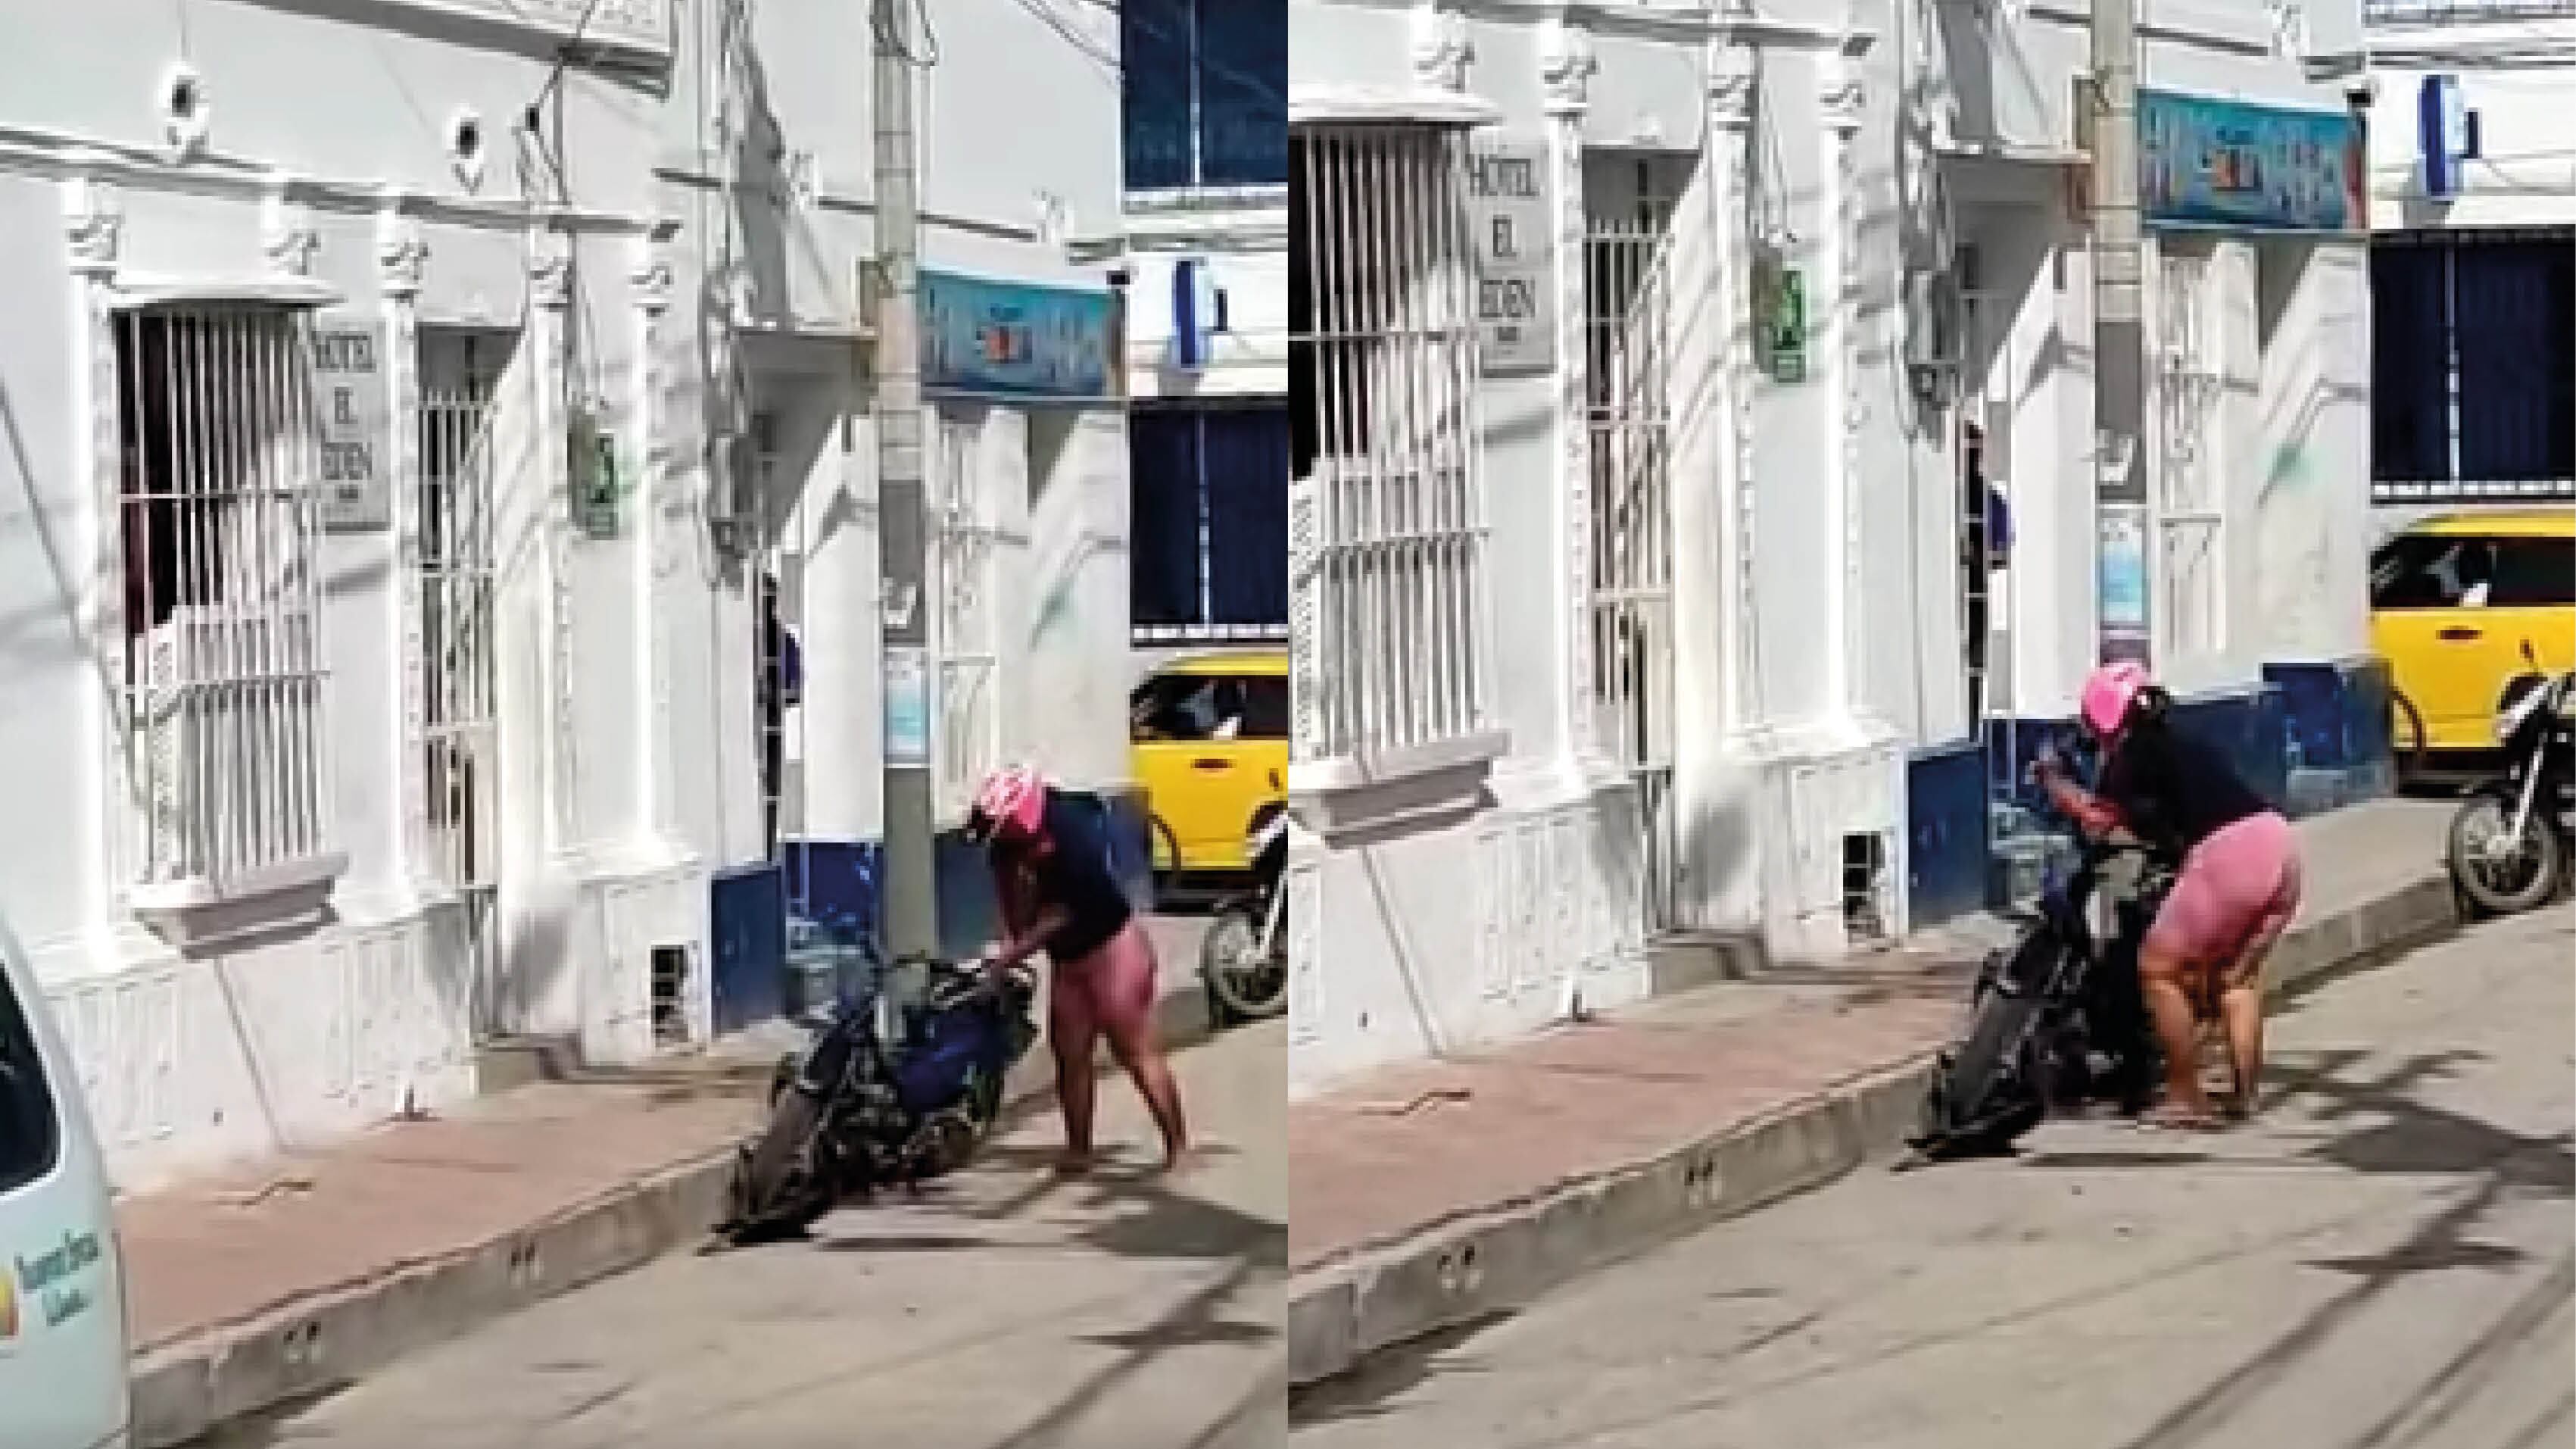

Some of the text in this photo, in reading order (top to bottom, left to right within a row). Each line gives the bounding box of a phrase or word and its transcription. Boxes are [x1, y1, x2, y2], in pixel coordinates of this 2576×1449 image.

[1468, 155, 1539, 197] HOTEL
[1492, 216, 1517, 258] EL
[1479, 279, 1536, 319] EDEN
[314, 332, 376, 372] HOTEL
[323, 441, 373, 481] EDEN
